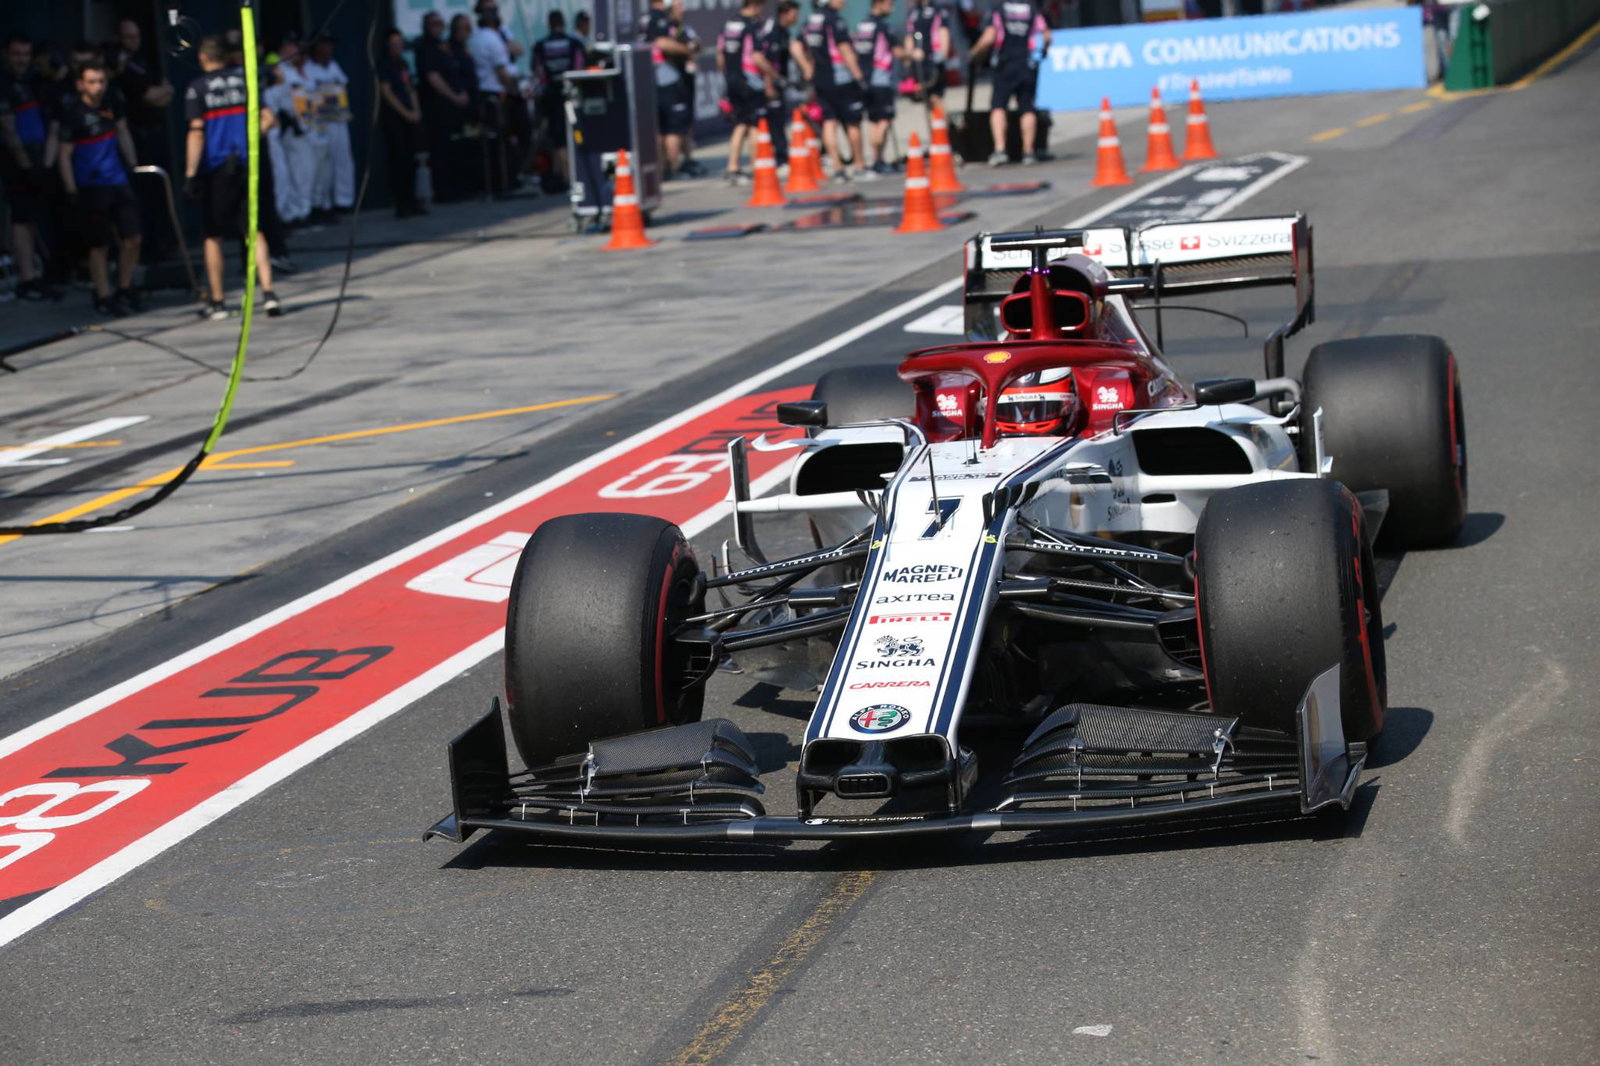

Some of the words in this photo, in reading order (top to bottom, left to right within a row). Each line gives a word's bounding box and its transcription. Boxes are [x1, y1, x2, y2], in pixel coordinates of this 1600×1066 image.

[1051, 43, 1133, 71] TATA
[1142, 22, 1400, 65] COMMUNICATIONS
[1207, 230, 1292, 249] Svizzera
[1092, 402, 1125, 410] SINGHA
[932, 409, 963, 418] SINGHA
[918, 495, 964, 541] 7
[883, 564, 963, 579] MAGNETI
[883, 570, 963, 583] MARELLI
[868, 612, 952, 625] PIRELLI
[856, 658, 936, 669] SINGHA
[849, 681, 931, 690] CARRERA
[40, 645, 394, 778] KUB
[880, 704, 910, 719] ROMEO
